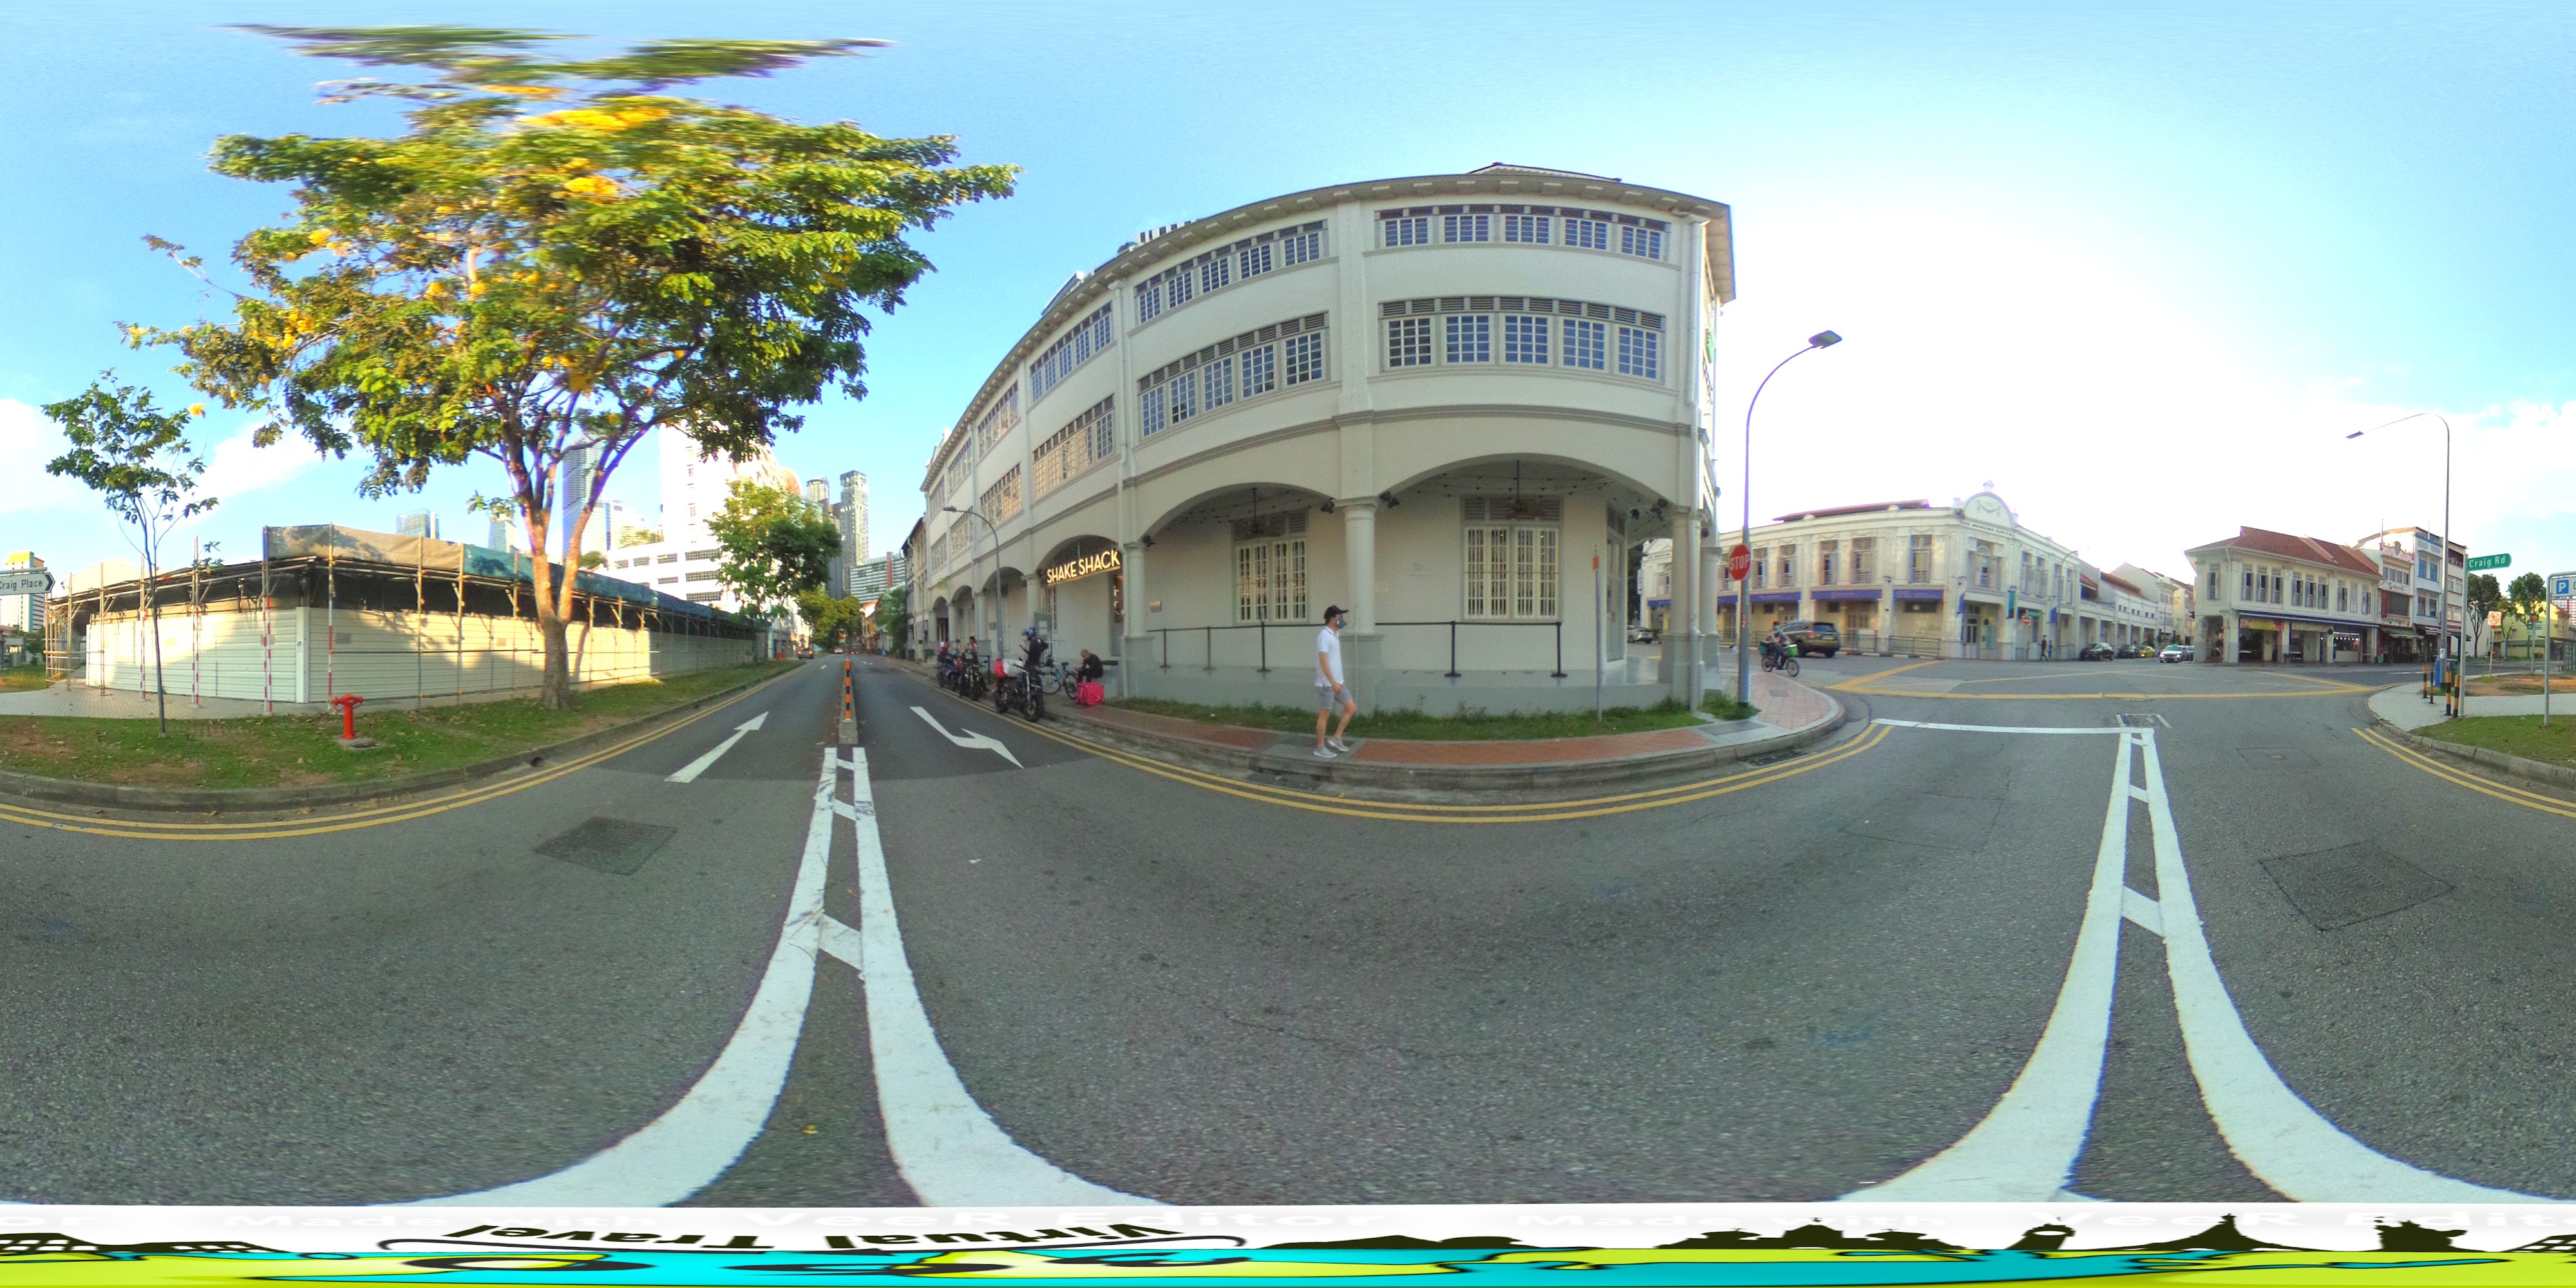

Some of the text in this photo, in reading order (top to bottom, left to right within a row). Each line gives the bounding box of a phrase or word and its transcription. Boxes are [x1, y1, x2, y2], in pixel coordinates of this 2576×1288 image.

[1046, 549, 1120, 583] SHAKE SHACK
[1730, 554, 1750, 571] STOP
[2469, 556, 2506, 567] Craig Rd
[21, 579, 43, 588] Place
[2559, 582, 2566, 592] P
